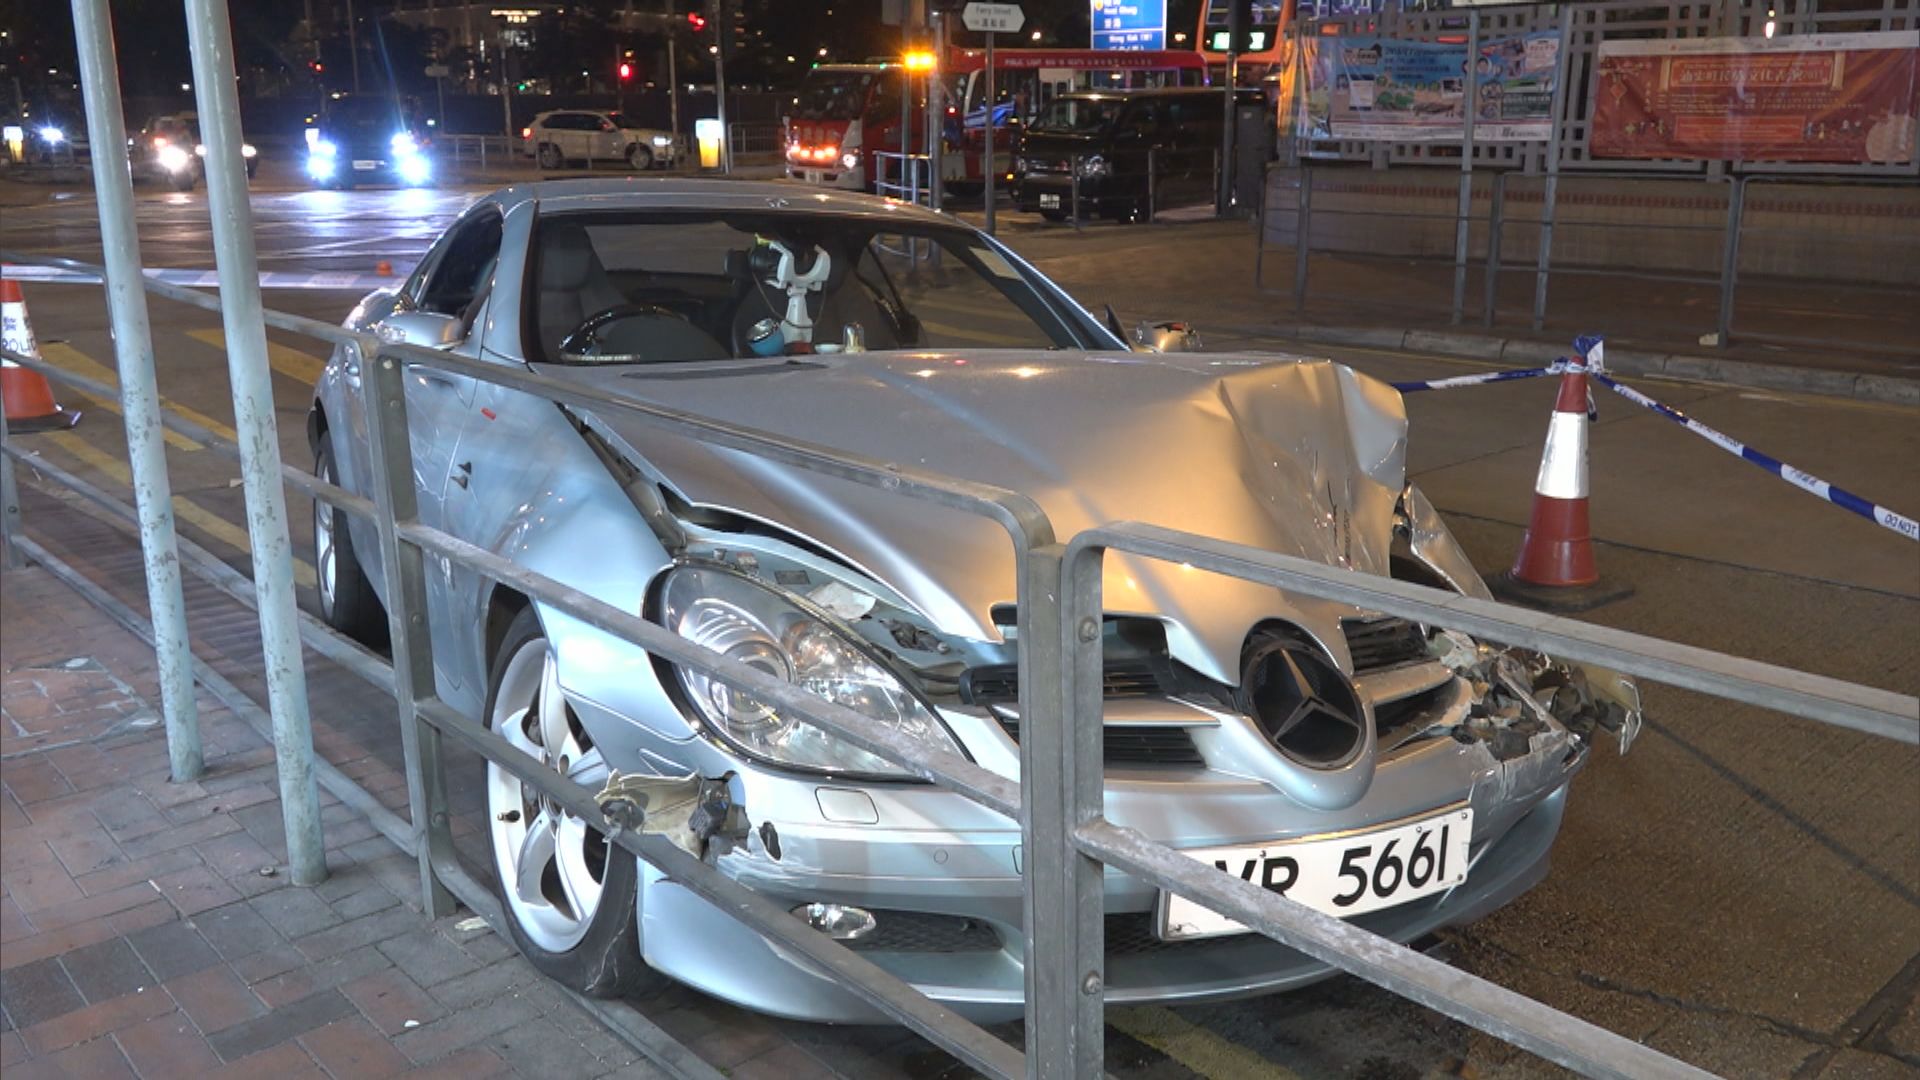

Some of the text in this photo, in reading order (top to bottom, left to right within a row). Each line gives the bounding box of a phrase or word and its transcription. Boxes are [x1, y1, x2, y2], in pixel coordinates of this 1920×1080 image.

[1884, 514, 1918, 536] DO NOT
[1331, 824, 1450, 907] 5661
